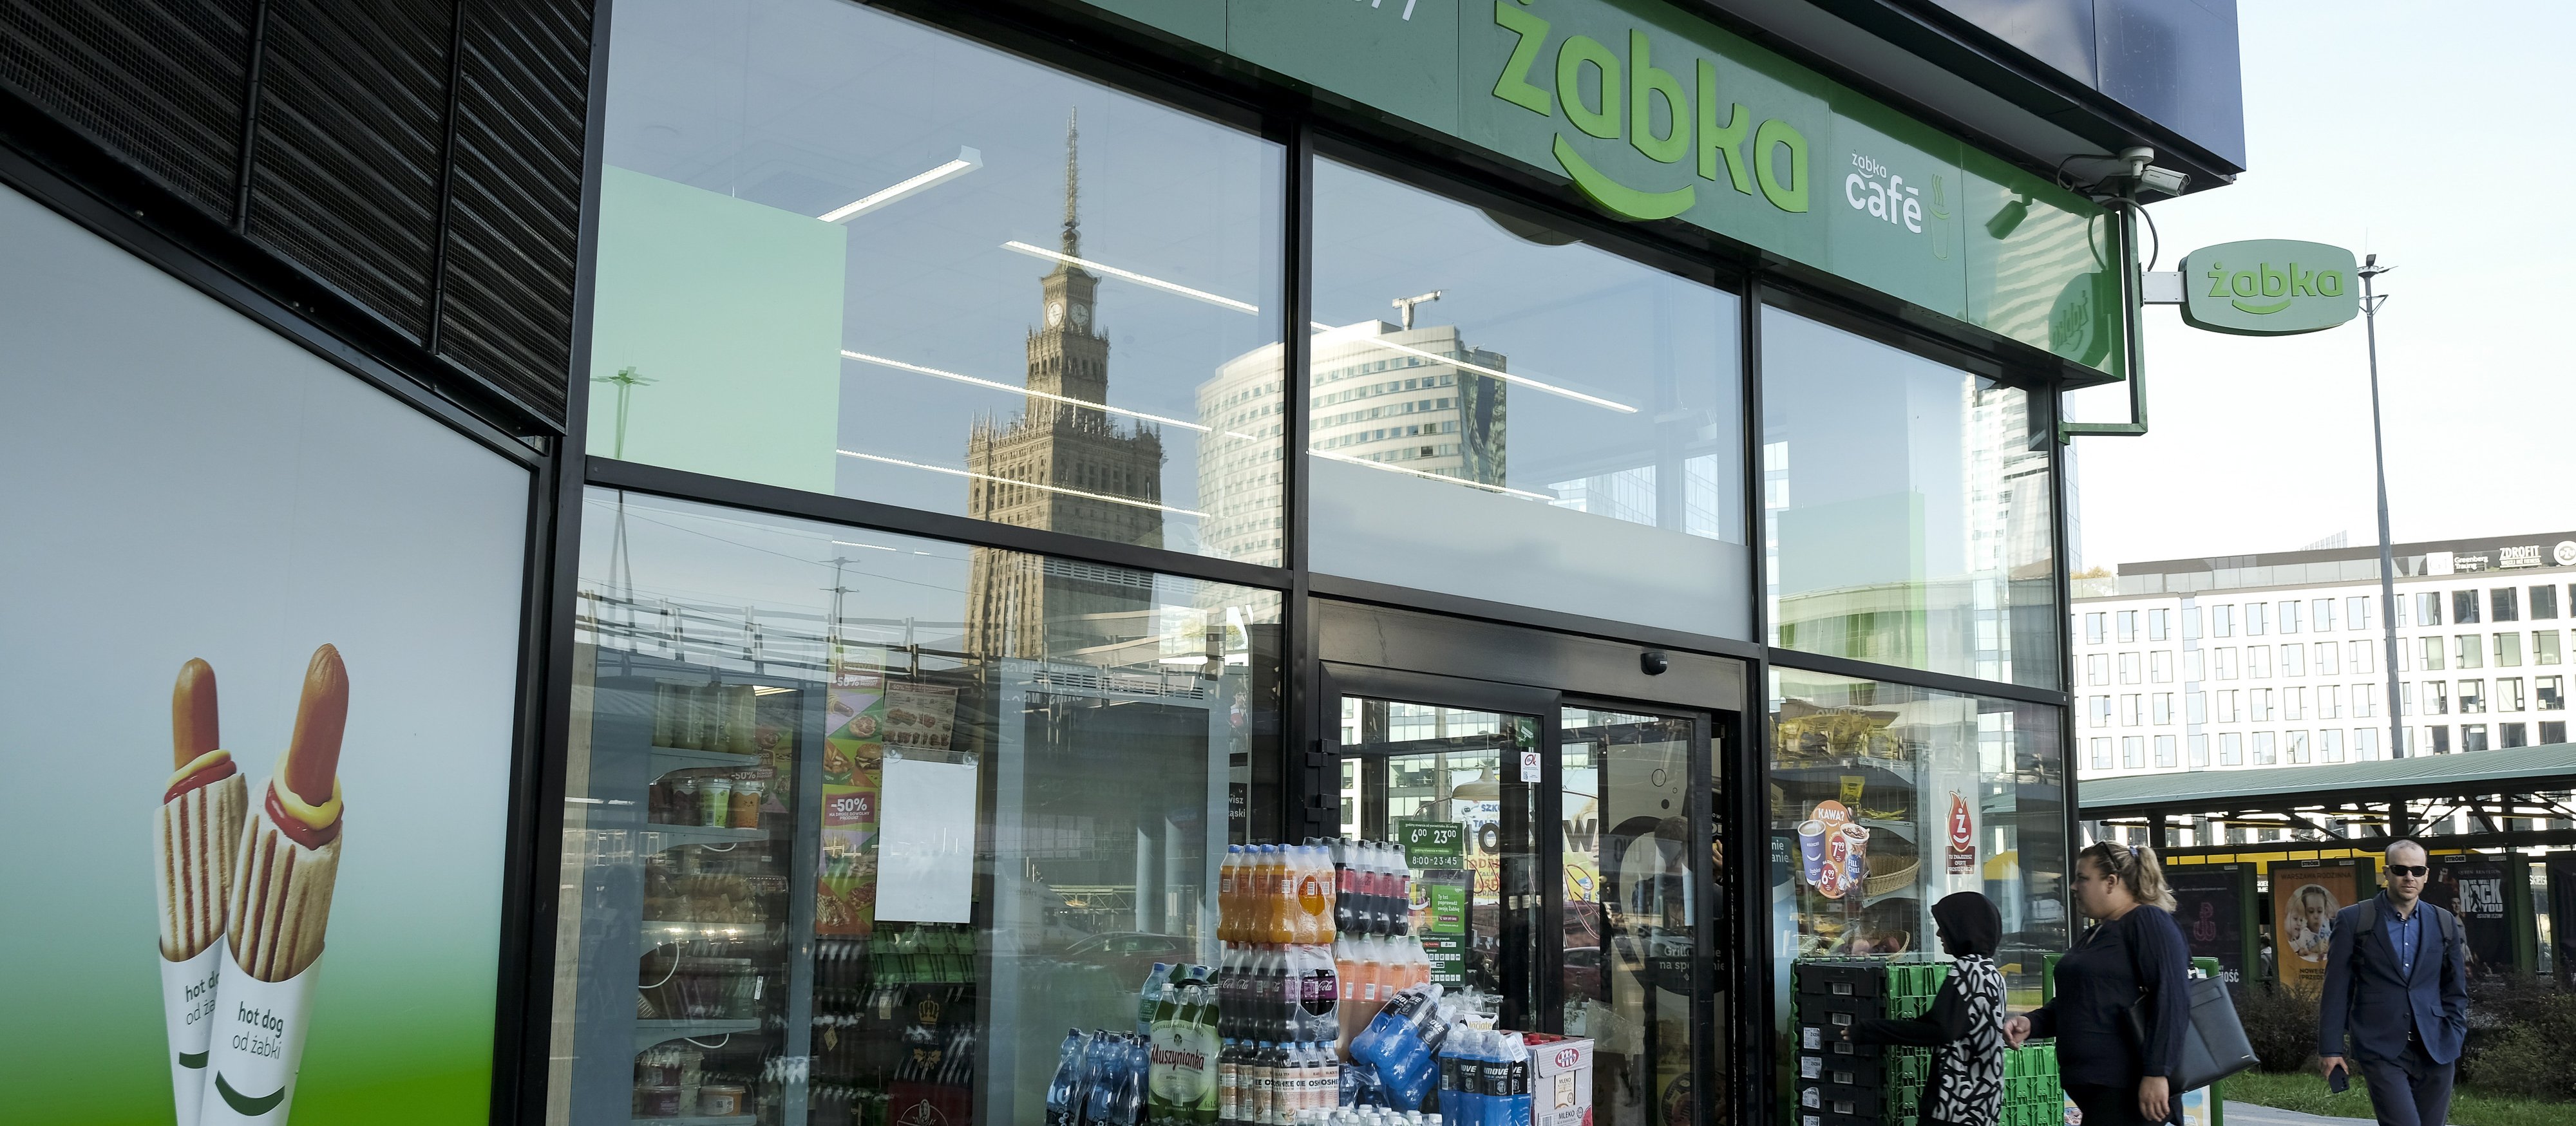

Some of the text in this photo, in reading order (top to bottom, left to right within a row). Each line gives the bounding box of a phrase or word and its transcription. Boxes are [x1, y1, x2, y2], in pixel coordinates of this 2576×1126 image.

[1492, 0, 1809, 212] żabka
[1852, 149, 1886, 178] żabka
[2207, 261, 2344, 297] żabka
[2454, 555, 2488, 563] Greenberg
[2499, 545, 2539, 559] ZDROFIT
[833, 677, 860, 687] -50%
[831, 798, 867, 812] -50%
[1818, 808, 1845, 821] KAWA?
[2483, 903, 2503, 912] YOU
[1660, 961, 1672, 970] na
[185, 970, 220, 1002] hot do
[186, 1002, 201, 1026] od
[238, 1000, 284, 1038] hot dog
[232, 1031, 282, 1060] od żabki
[1150, 1043, 1206, 1072] Muszynianka
[1309, 1078, 1320, 1087] OSH
[1558, 1110, 1575, 1120] MLEKO
